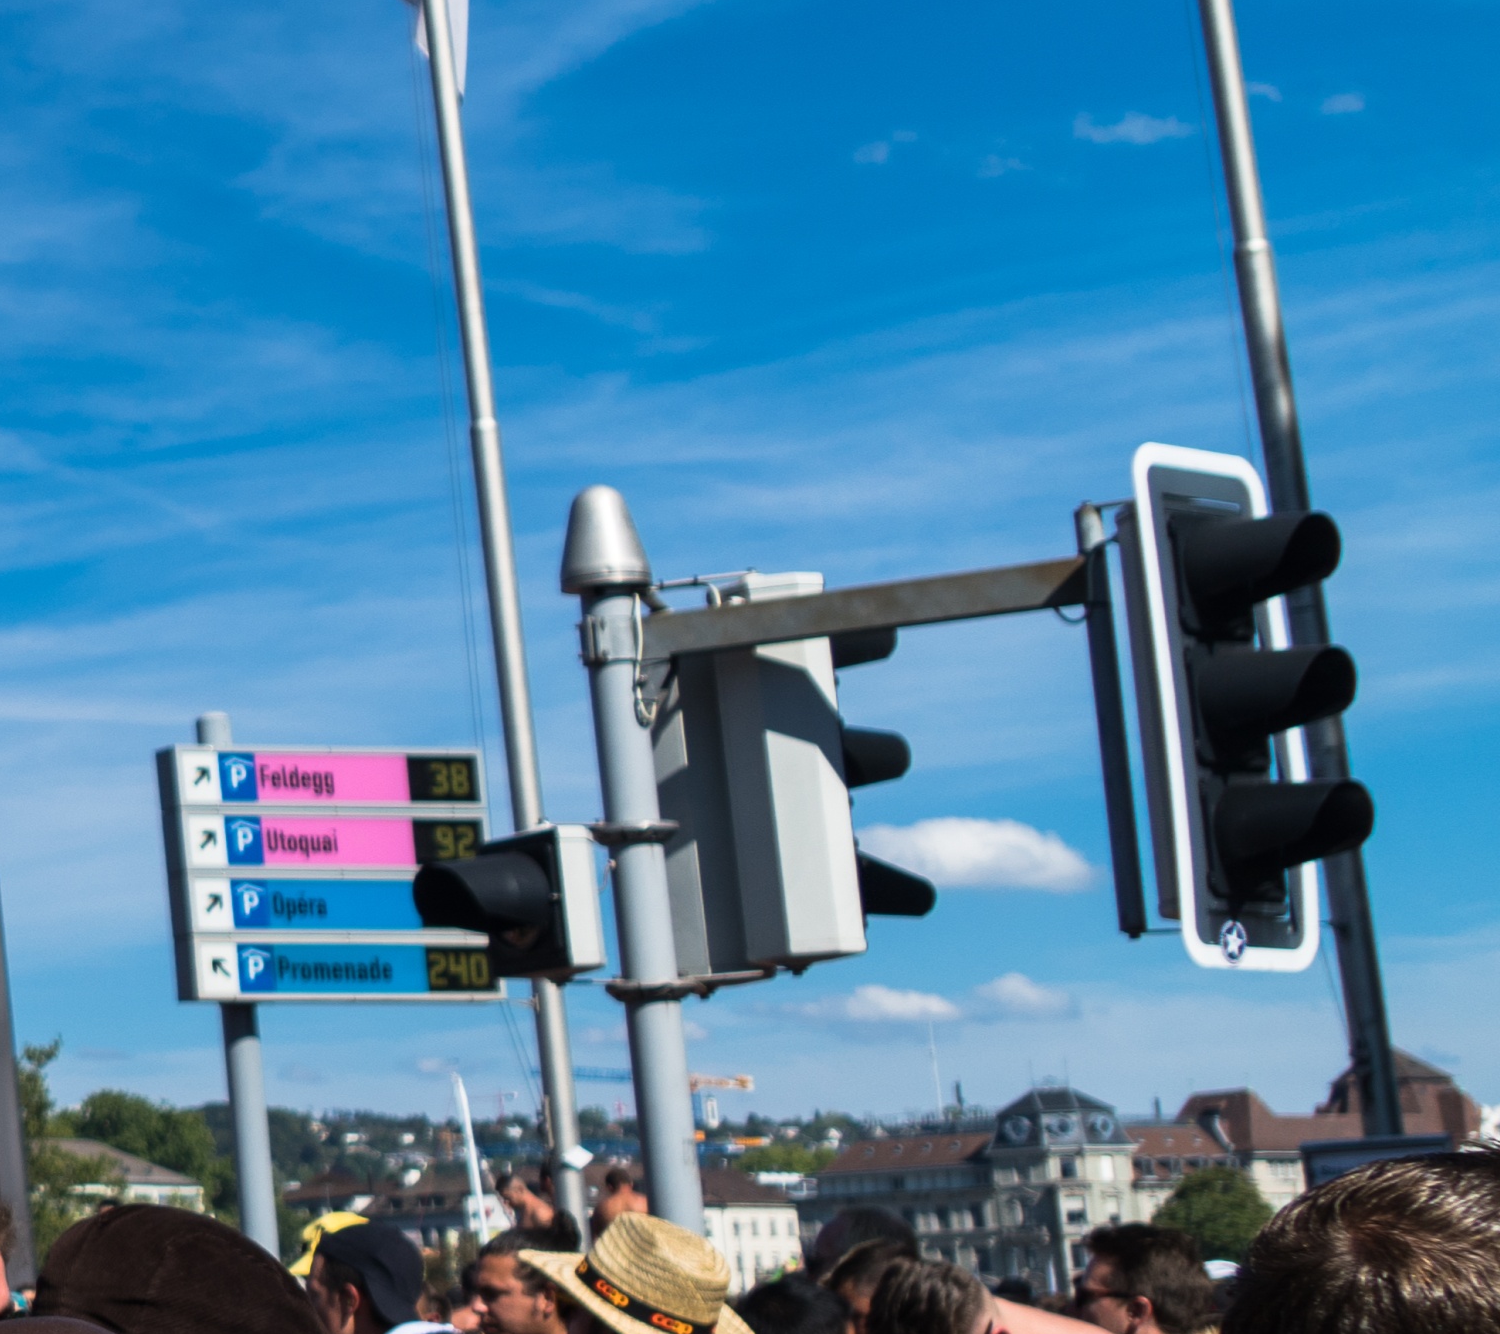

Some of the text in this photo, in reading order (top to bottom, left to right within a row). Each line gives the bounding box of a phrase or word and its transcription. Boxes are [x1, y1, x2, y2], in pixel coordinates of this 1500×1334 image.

[231, 761, 471, 797] P Feldegg 38
[237, 825, 477, 860] P Utoquai 92
[243, 890, 260, 916] P
[248, 951, 490, 987] P Promenade 240
